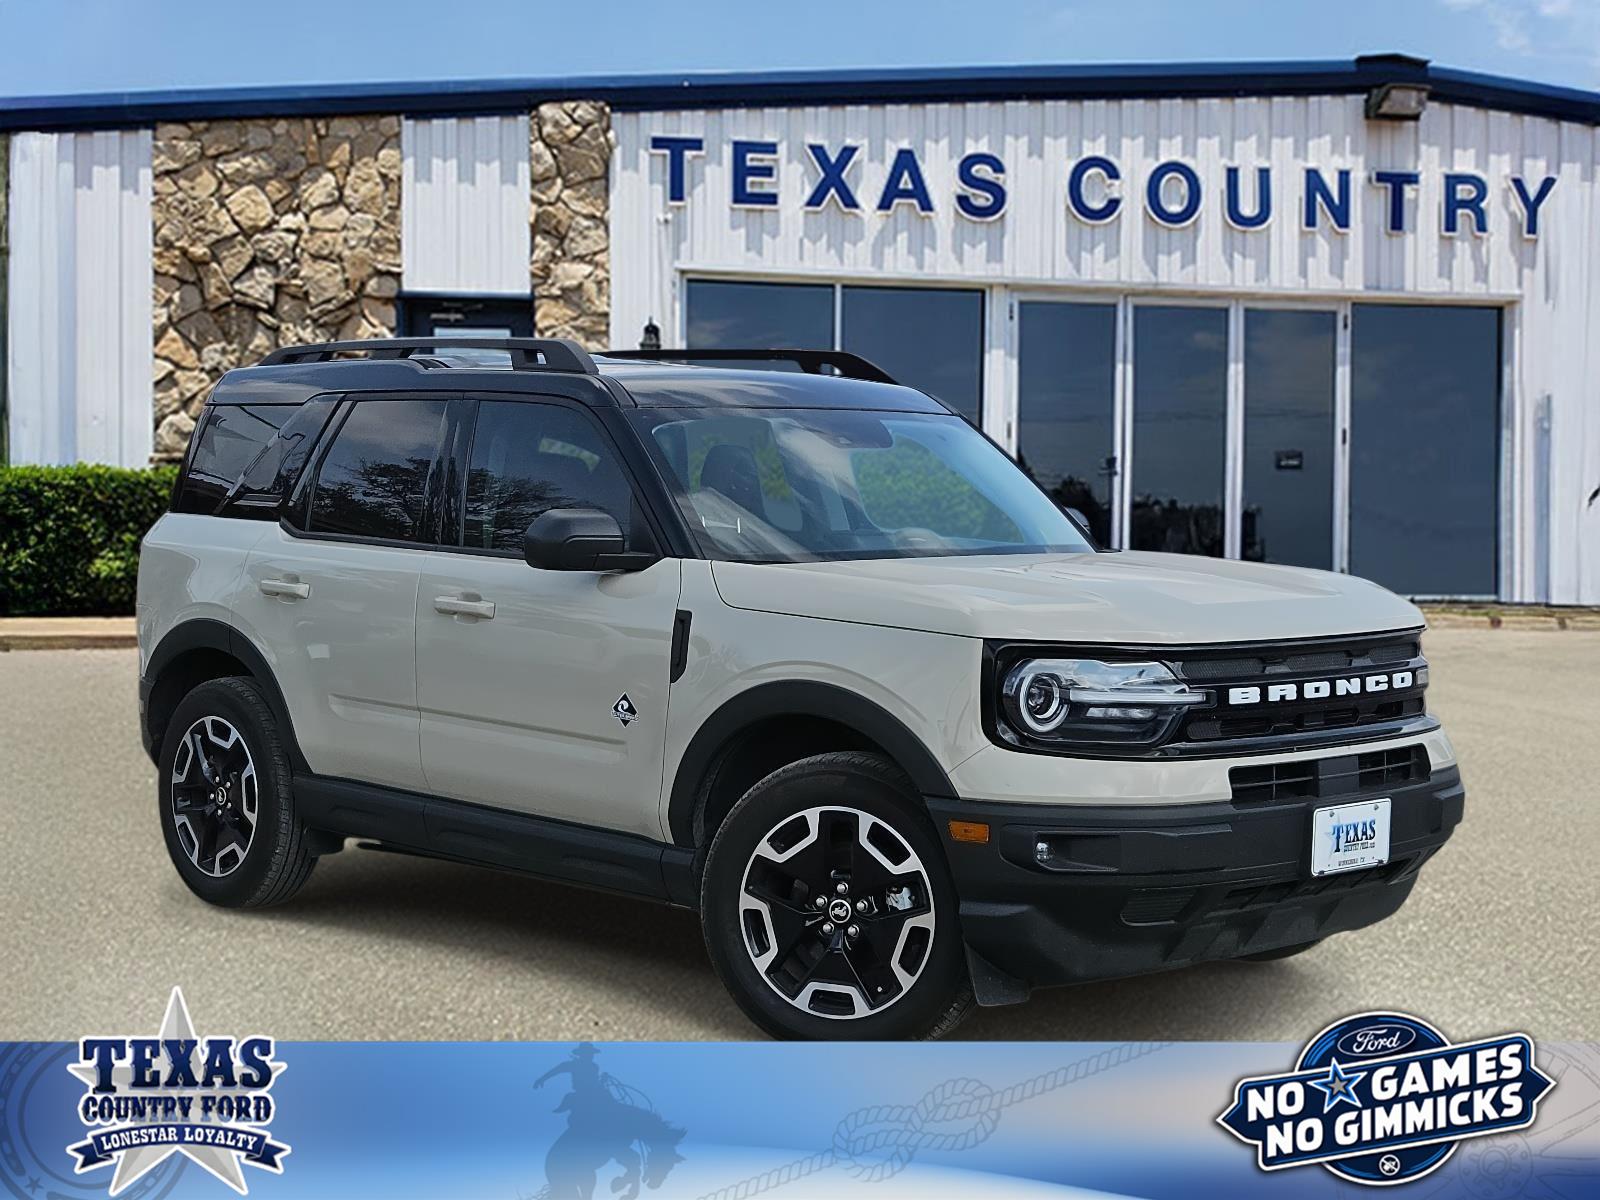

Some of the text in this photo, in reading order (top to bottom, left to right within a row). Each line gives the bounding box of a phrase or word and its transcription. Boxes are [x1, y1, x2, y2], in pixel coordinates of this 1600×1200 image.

[651, 136, 1557, 239] TEXAS COUNTRY
[1228, 671, 1414, 706] BRONCO
[1331, 819, 1376, 853] TEXAS
